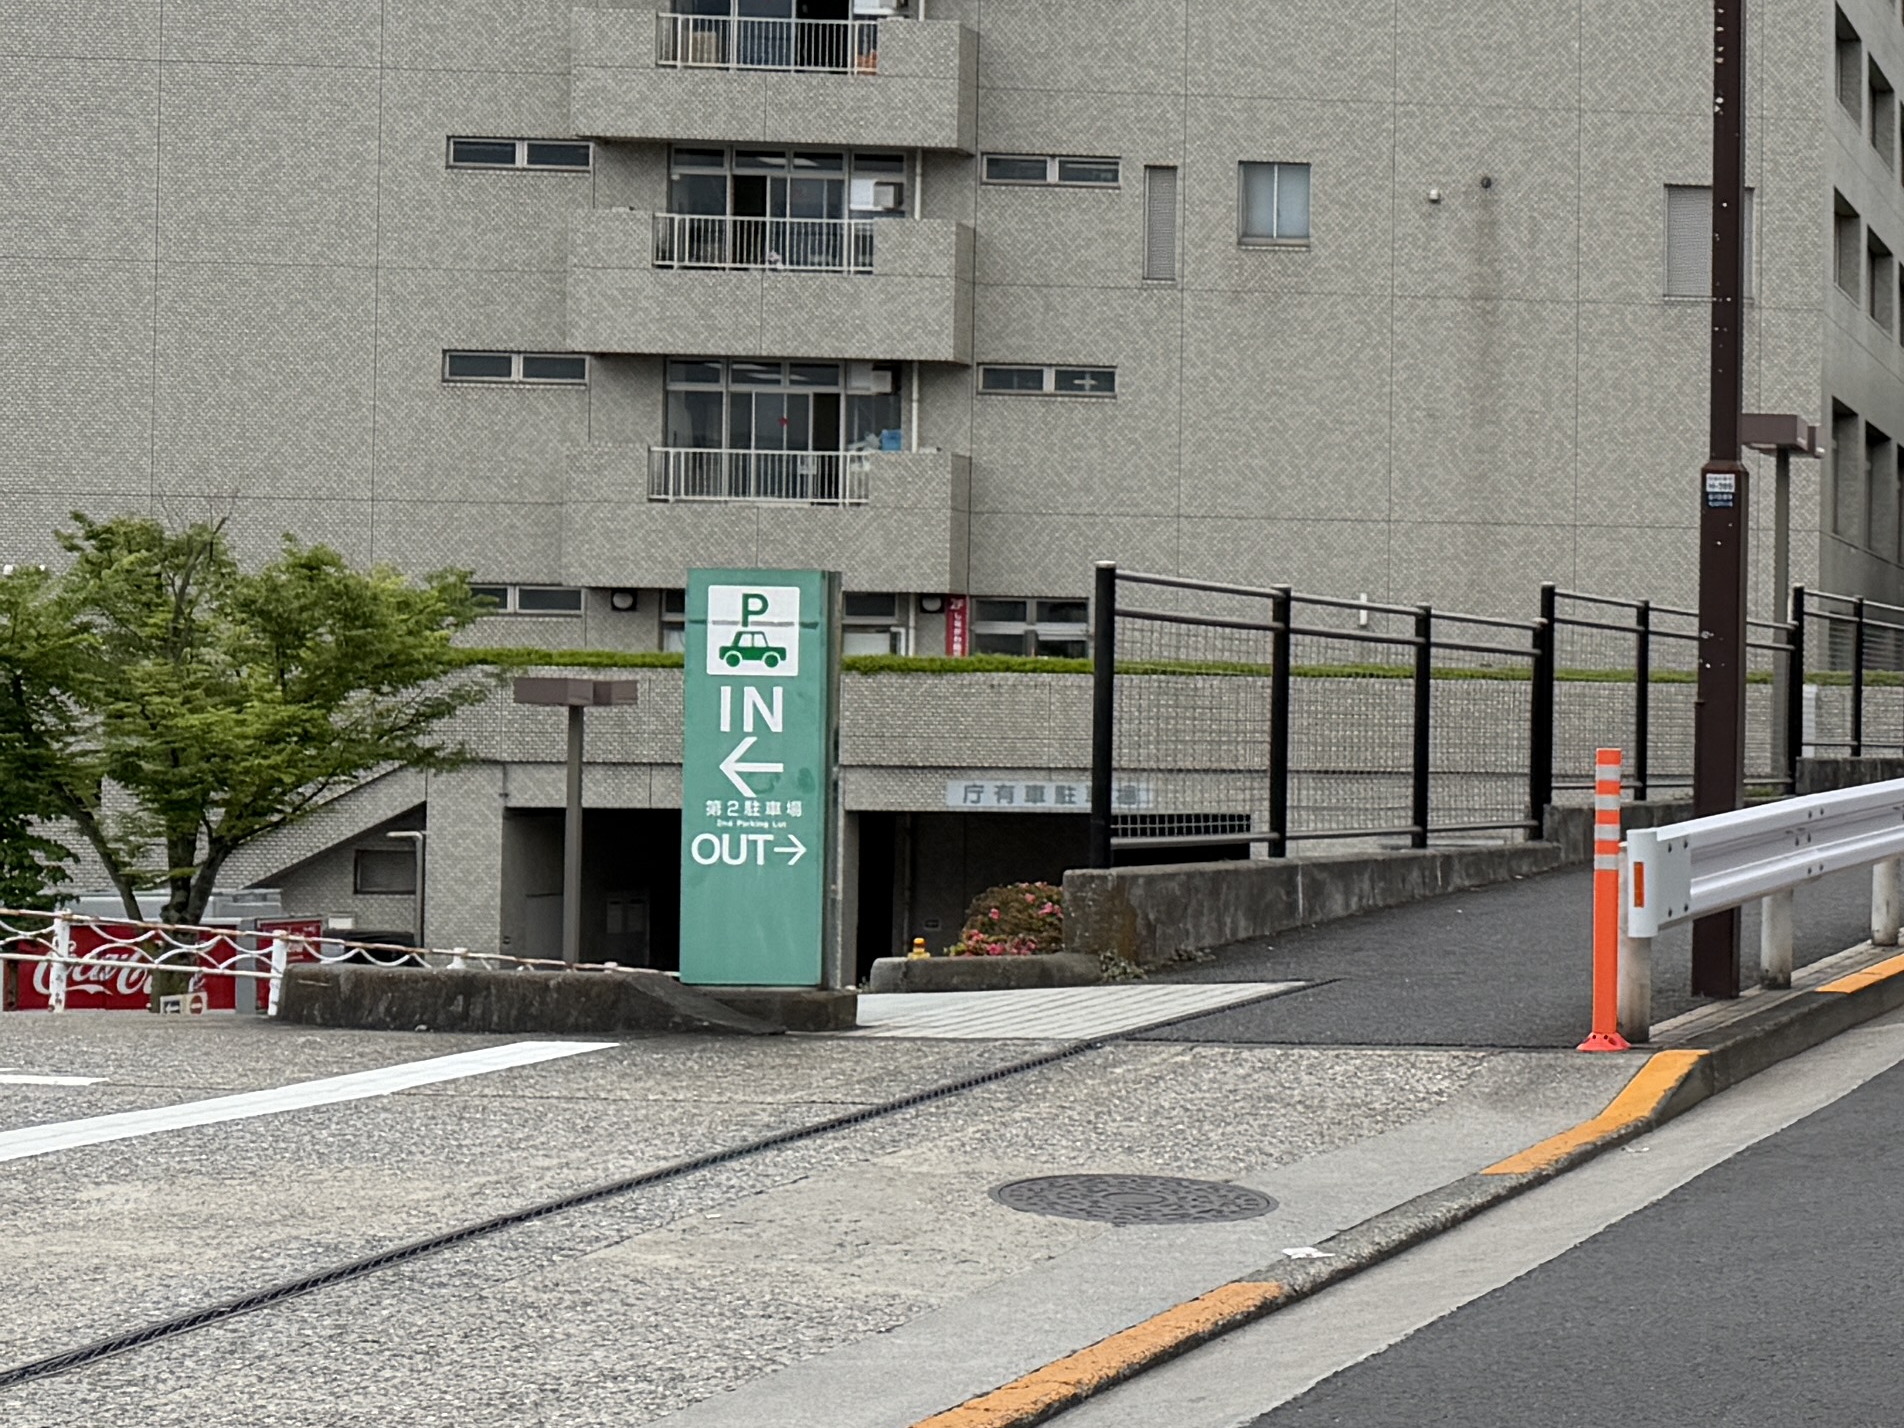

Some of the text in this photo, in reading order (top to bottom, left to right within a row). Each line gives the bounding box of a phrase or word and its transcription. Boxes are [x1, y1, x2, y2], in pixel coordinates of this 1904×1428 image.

[741, 593, 769, 628] P
[720, 686, 783, 733] IN
[706, 800, 802, 817] 第2駐車場
[963, 784, 1138, 805] 庁有車駐場
[691, 833, 774, 865] OUT
